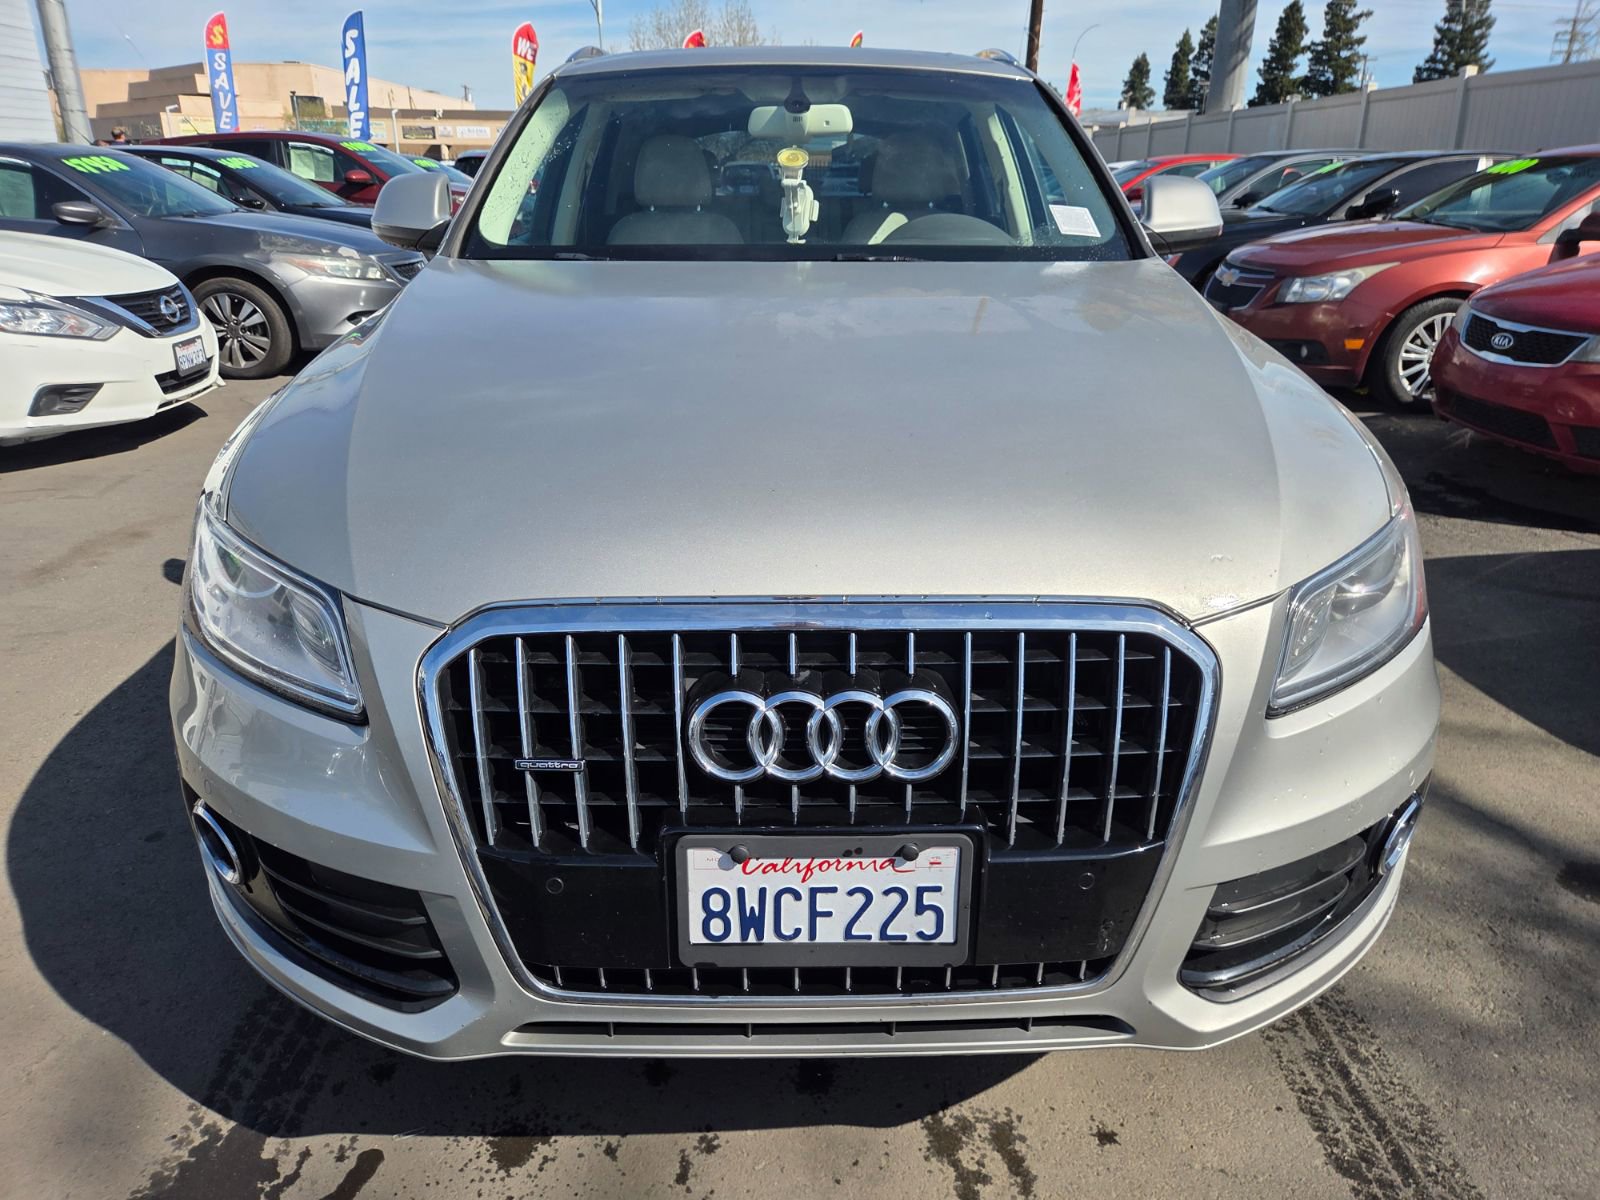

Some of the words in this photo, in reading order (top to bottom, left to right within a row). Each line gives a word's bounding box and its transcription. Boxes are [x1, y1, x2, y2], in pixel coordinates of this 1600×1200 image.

[213, 52, 233, 129] SAVE
[344, 28, 365, 138] SALE
[1493, 335, 1509, 347] KIA
[741, 857, 916, 883] California
[701, 885, 945, 942] 8WCF225
